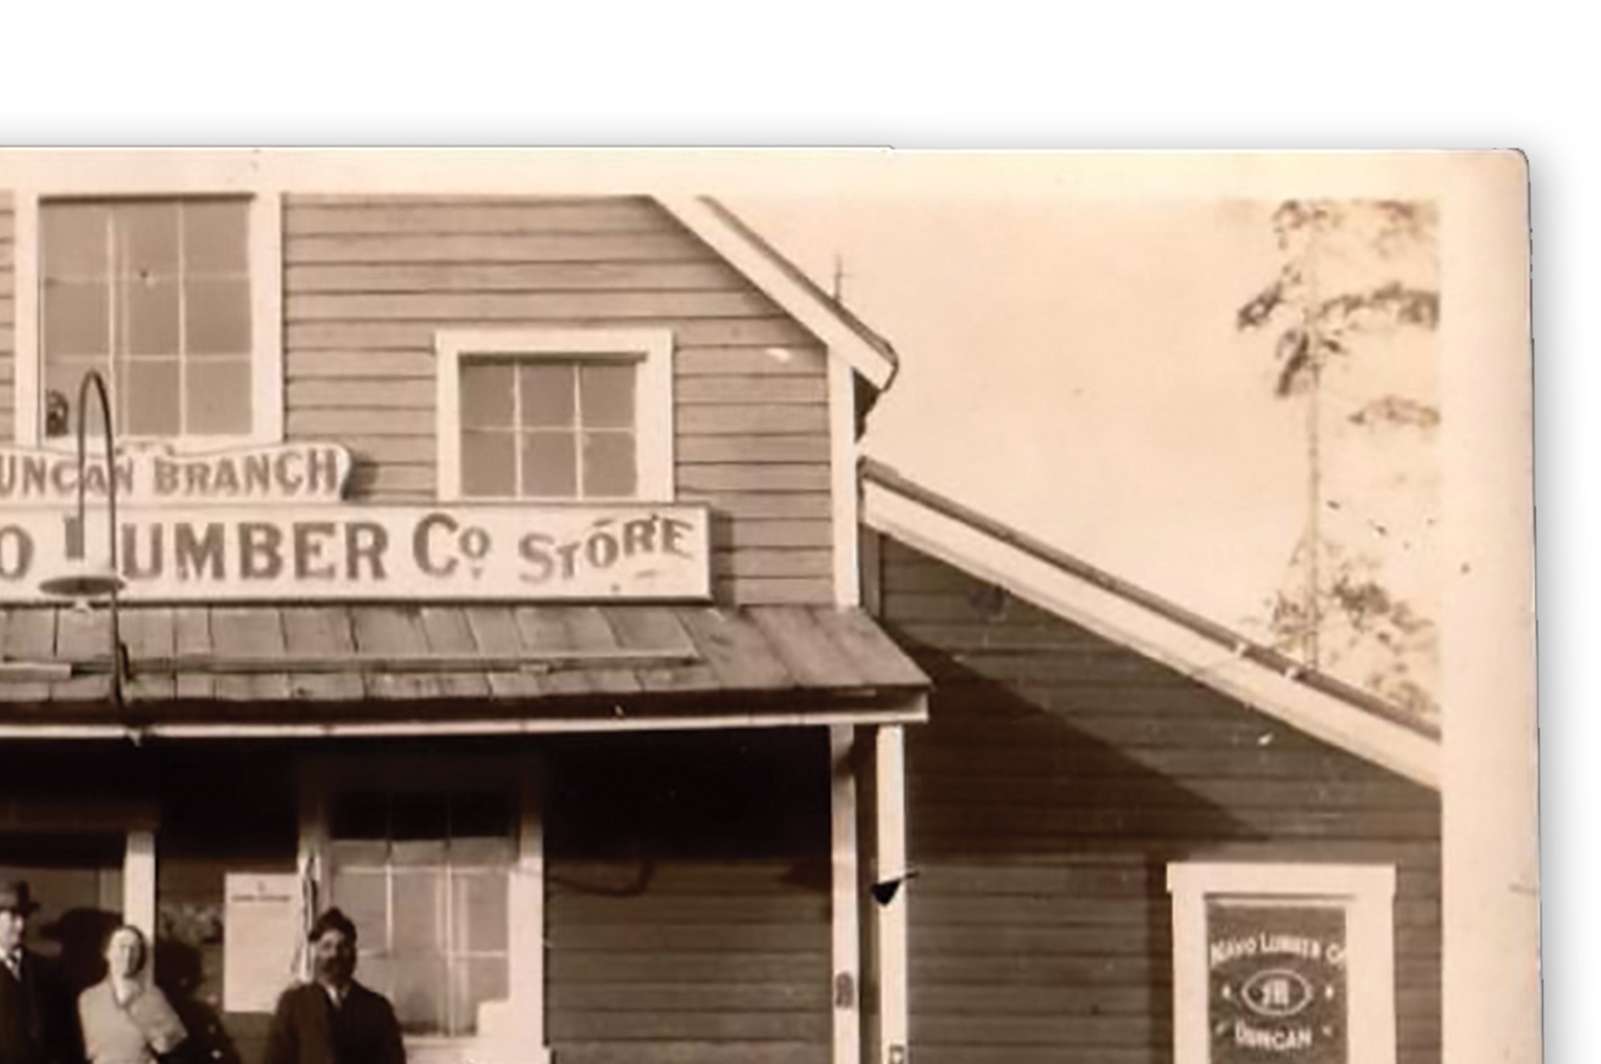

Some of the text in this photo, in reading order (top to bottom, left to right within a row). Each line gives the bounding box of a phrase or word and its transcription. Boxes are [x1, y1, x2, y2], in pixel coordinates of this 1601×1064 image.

[152, 447, 340, 497] BRANCH
[516, 514, 695, 583] STORE
[1235, 1018, 1314, 1051] DUNCAN
